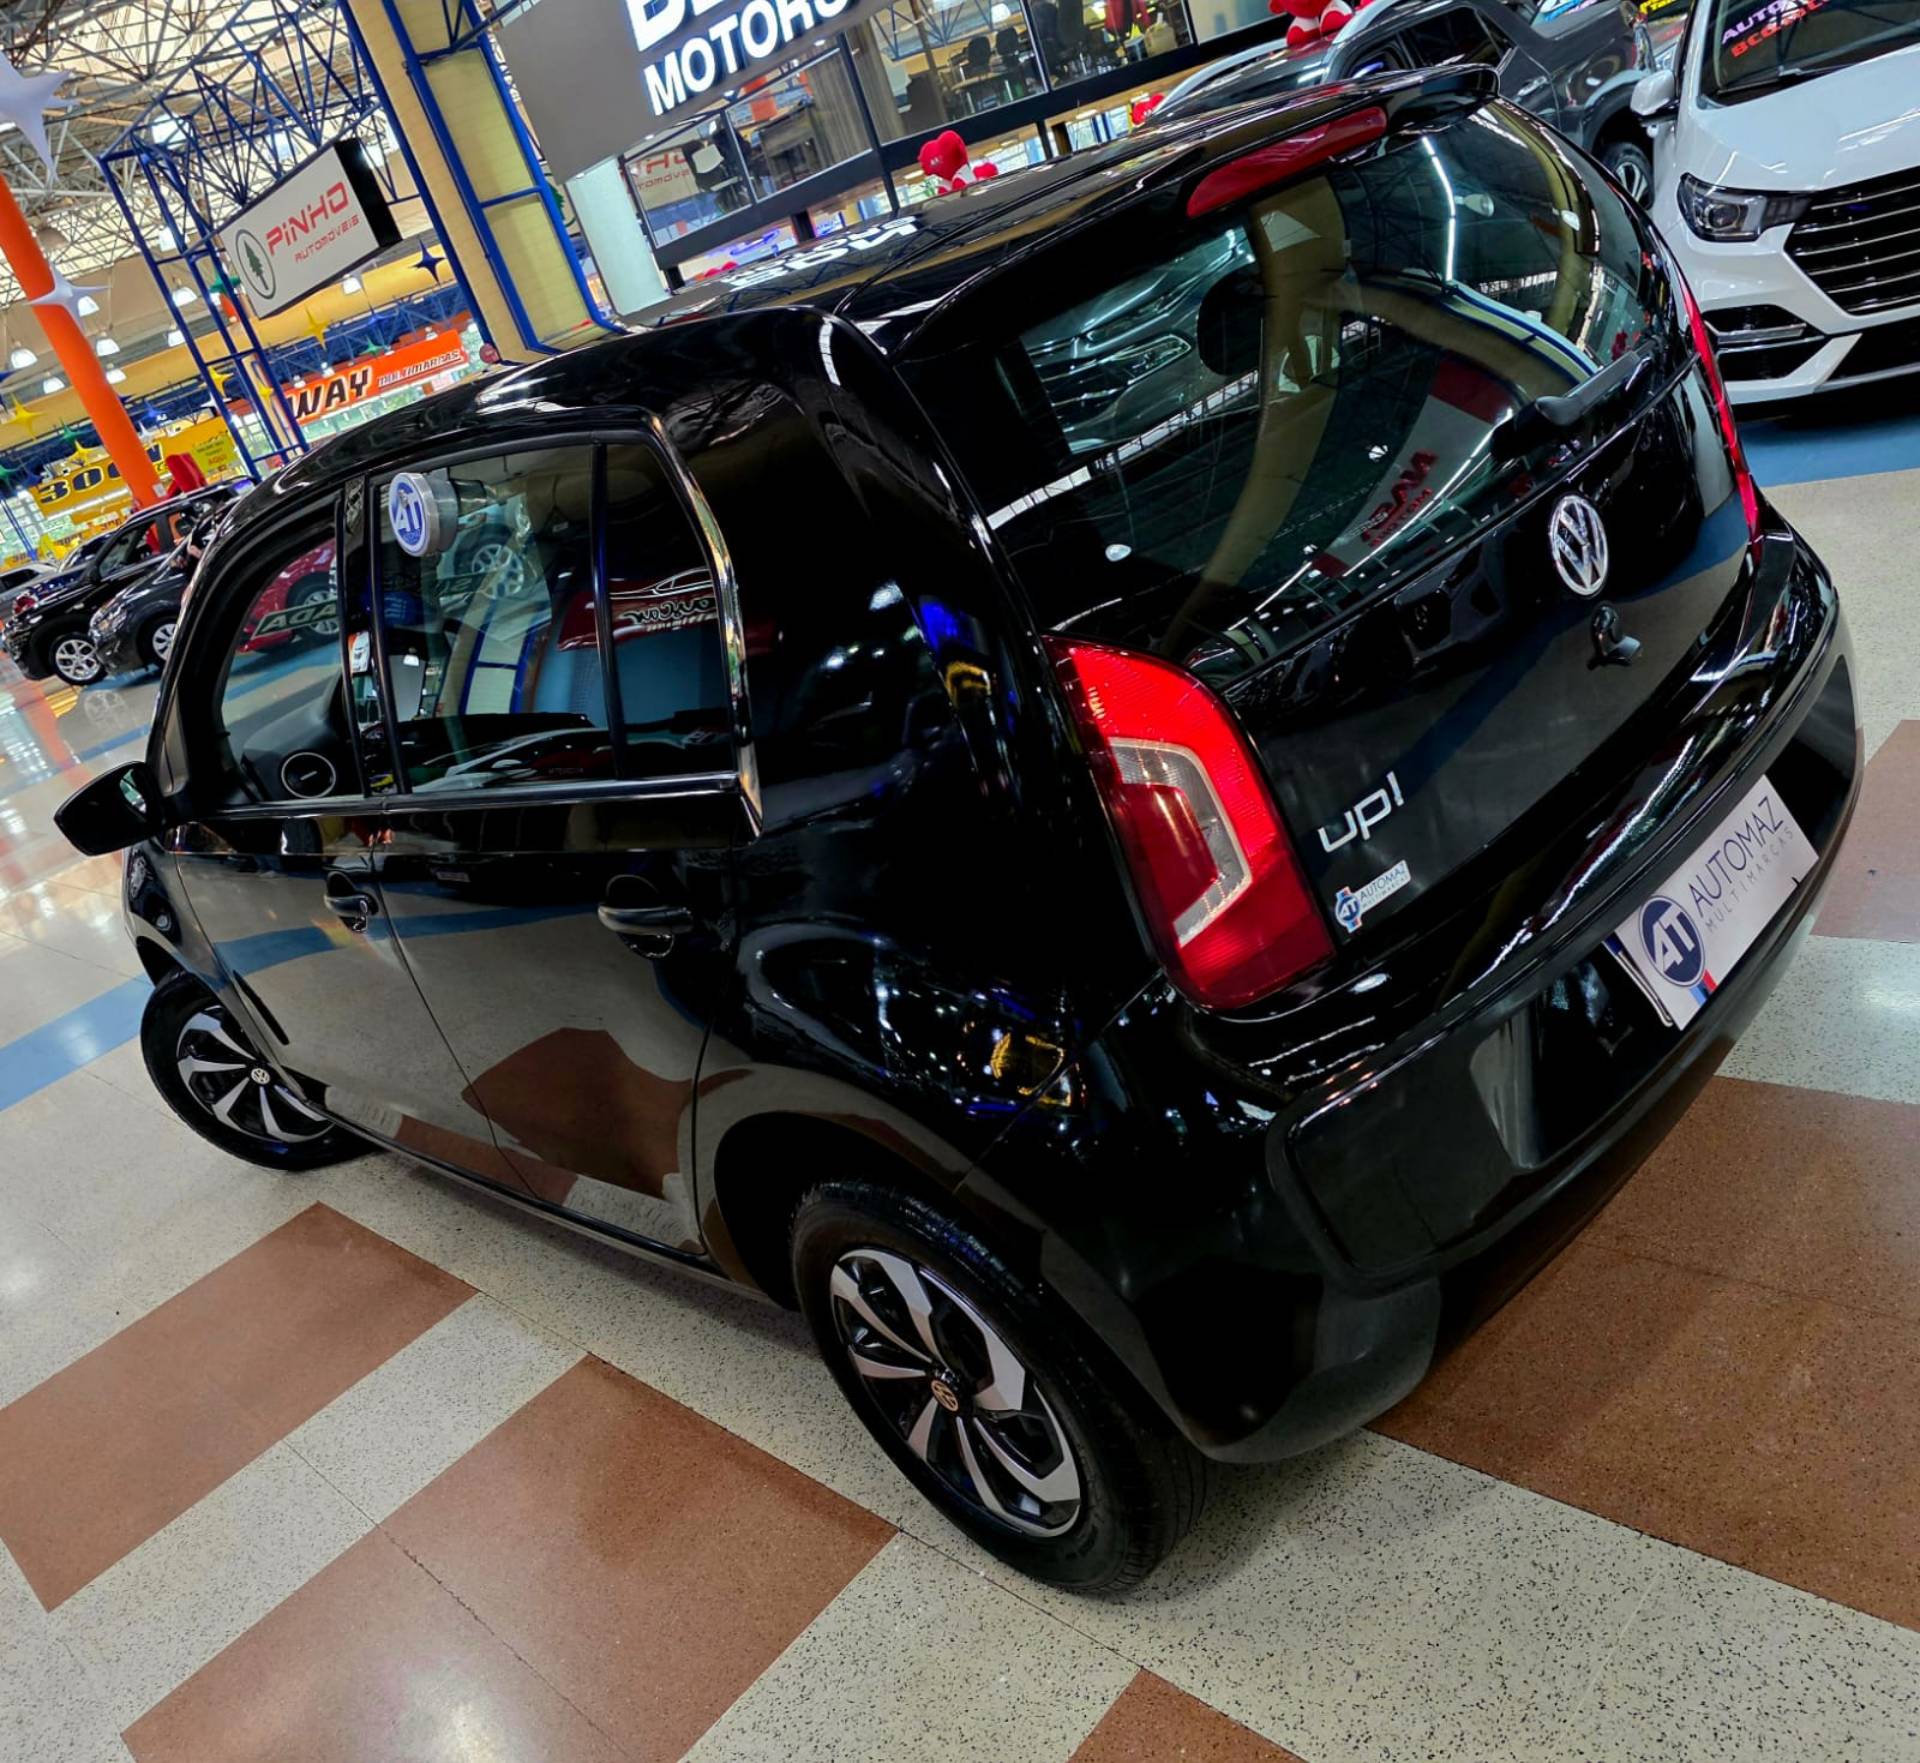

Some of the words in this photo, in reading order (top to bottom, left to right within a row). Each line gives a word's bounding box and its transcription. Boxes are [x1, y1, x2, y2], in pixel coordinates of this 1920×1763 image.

[1318, 770, 1404, 853] up!
[1688, 796, 1784, 918] AUTOMAZ
[1705, 828, 1794, 933] MULTIMARCAS
